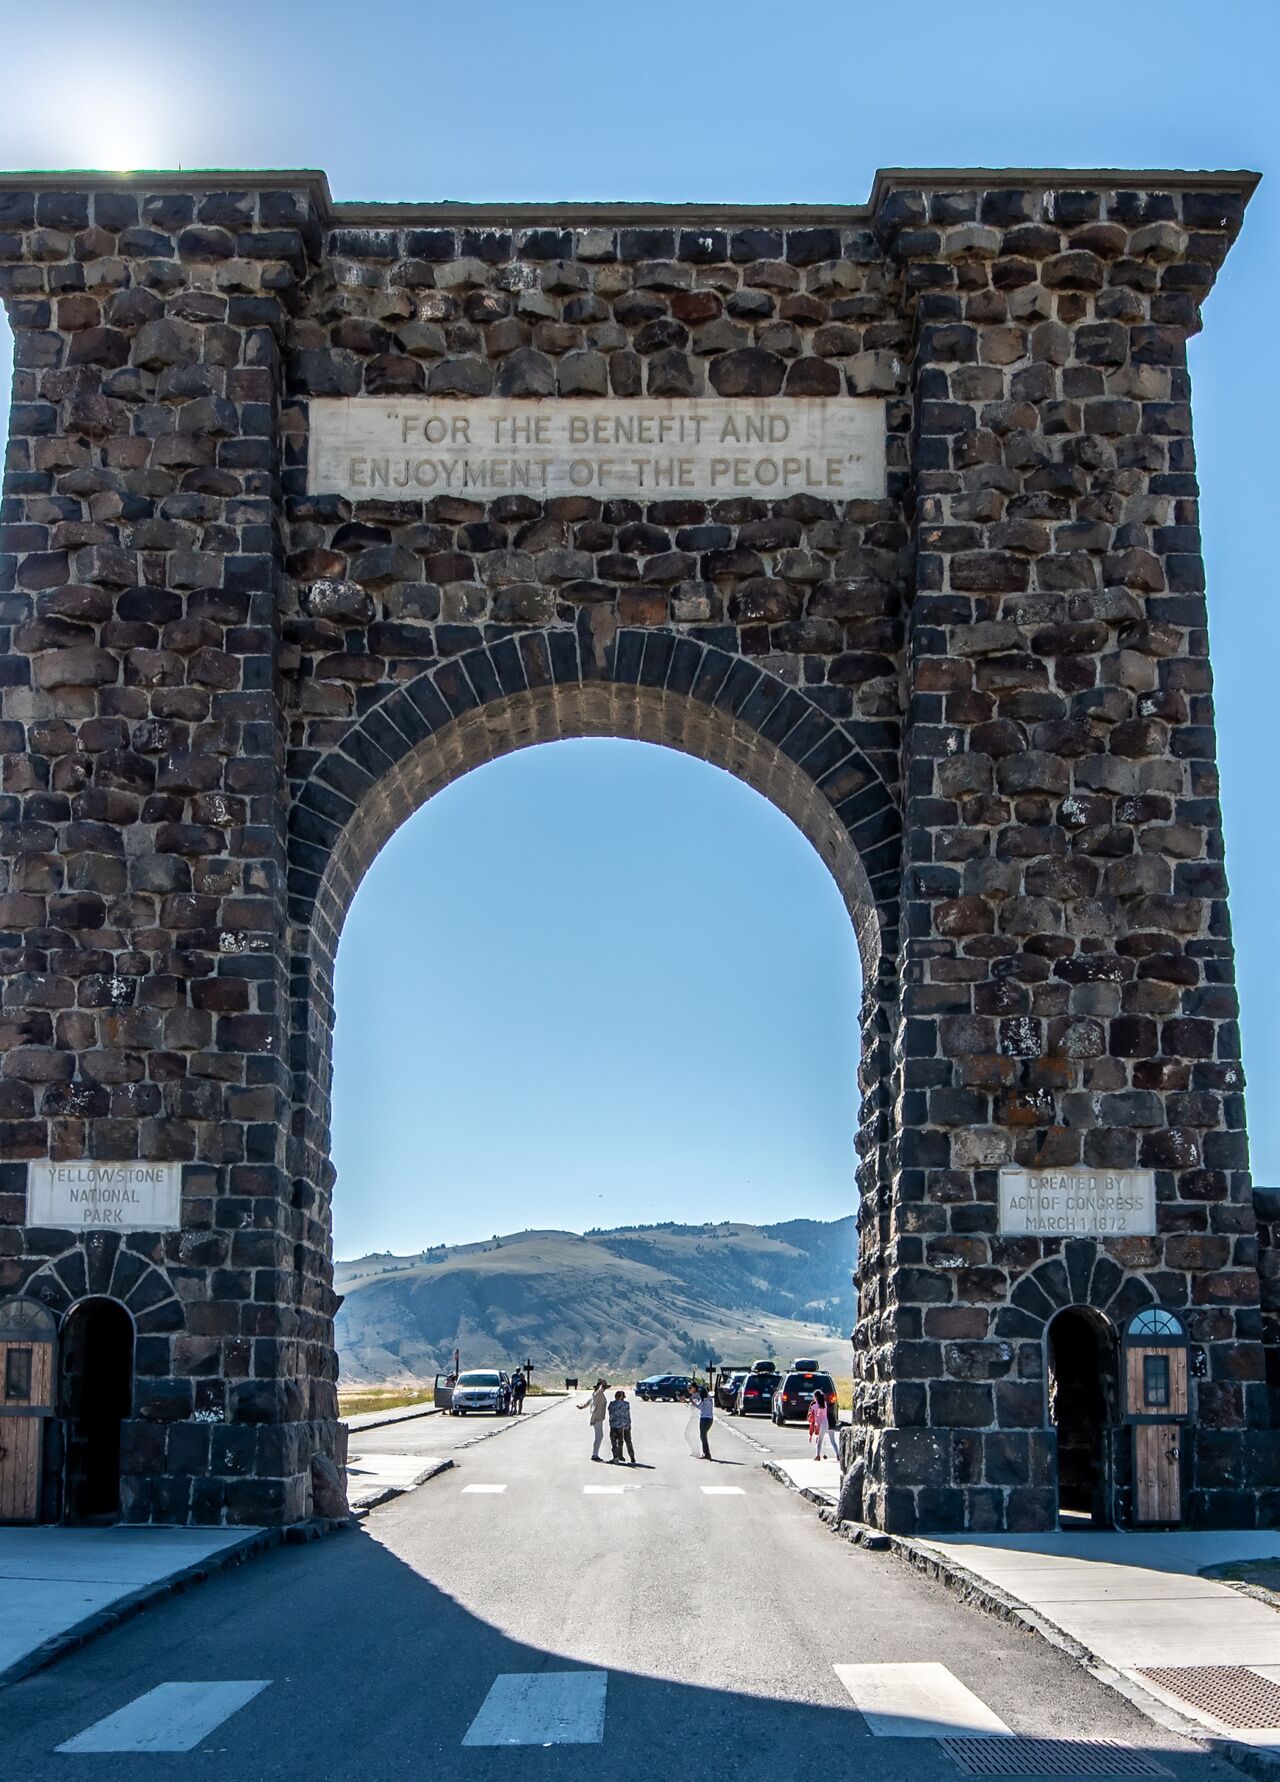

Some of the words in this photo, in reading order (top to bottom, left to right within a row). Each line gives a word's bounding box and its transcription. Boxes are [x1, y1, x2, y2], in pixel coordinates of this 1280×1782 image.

[490, 415, 551, 443] THE
[569, 415, 708, 443] BENEFIT
[720, 414, 790, 443] AND
[349, 457, 550, 488] ENJOYMENT
[569, 457, 614, 488] OF
[631, 457, 693, 487] THE
[49, 1168, 163, 1183] YELLOWSTONE
[1029, 1176, 1096, 1190] CREATED
[1106, 1176, 1124, 1190] BY
[71, 1189, 140, 1203] NATIONAL
[1010, 1196, 1034, 1210] ACT
[1042, 1196, 1060, 1210] OF
[1066, 1196, 1144, 1211] CONGRESS
[83, 1209, 122, 1223] PARK
[1025, 1217, 1075, 1230] MARCH
